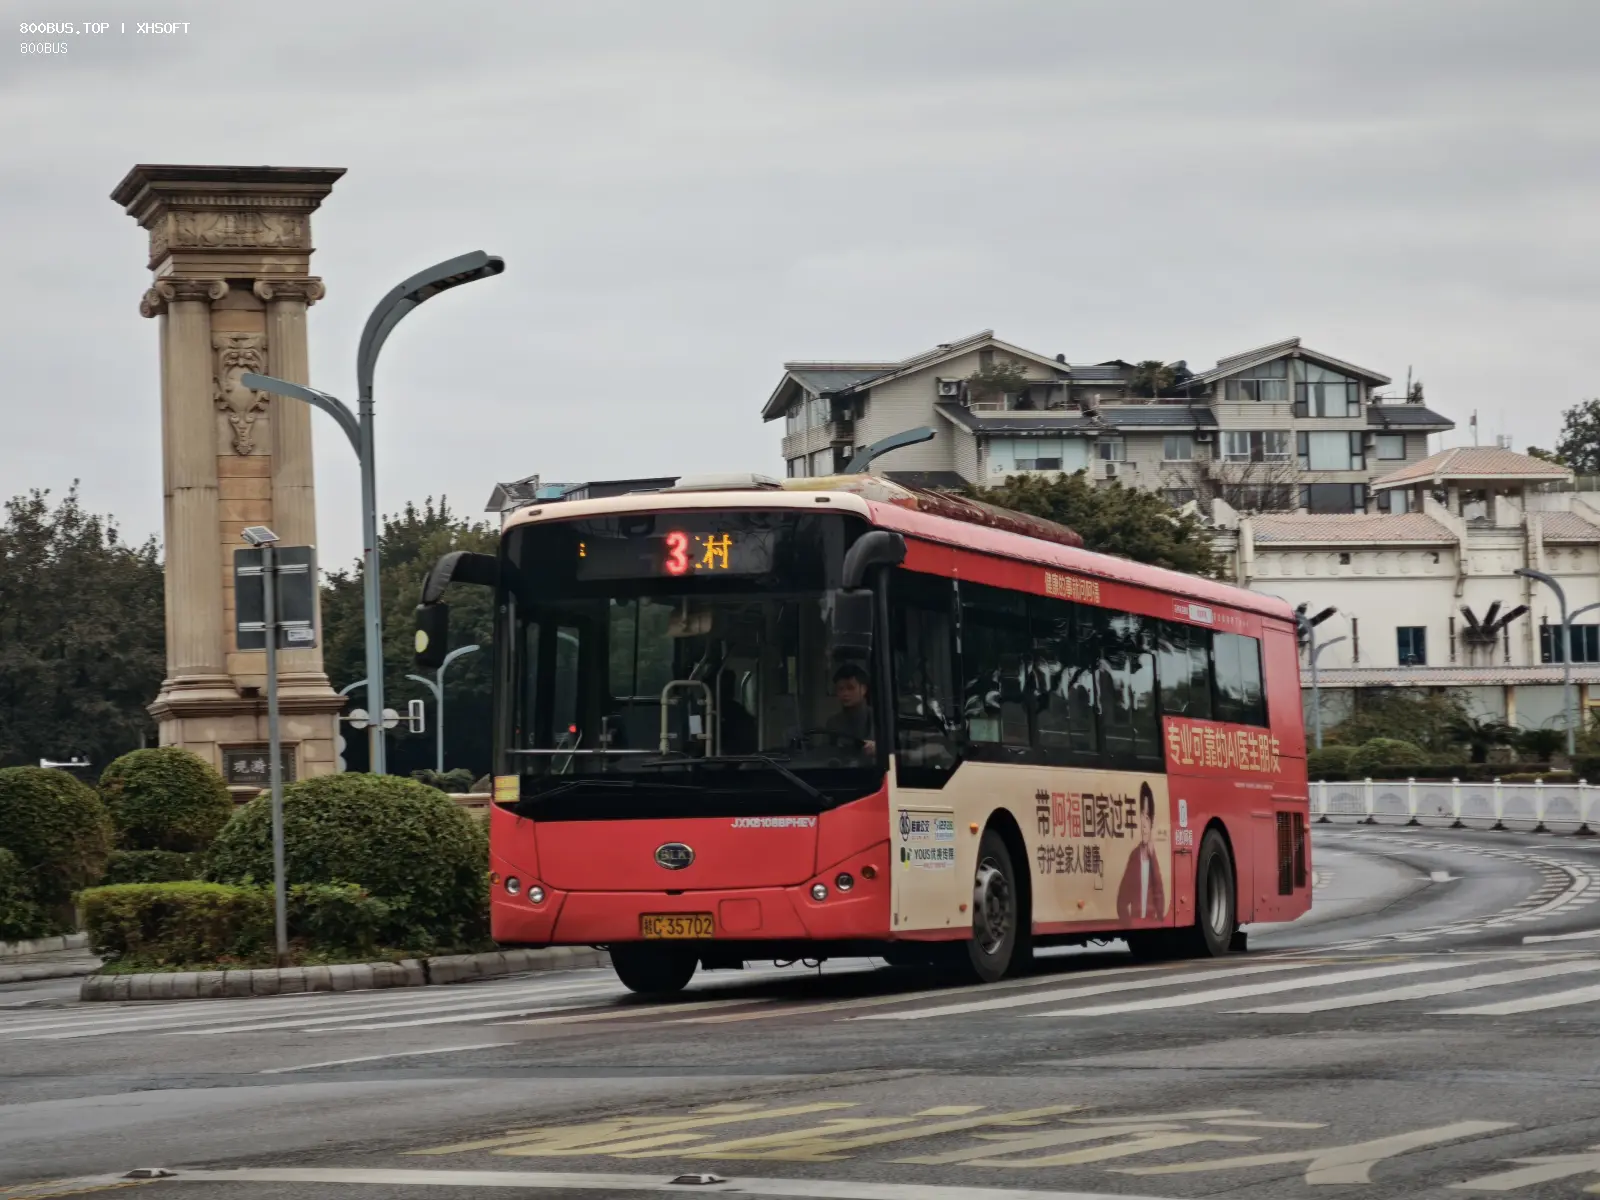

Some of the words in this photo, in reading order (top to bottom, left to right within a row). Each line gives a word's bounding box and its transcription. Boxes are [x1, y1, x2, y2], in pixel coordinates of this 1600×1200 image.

[665, 530, 690, 576] 3
[1167, 721, 1282, 774] 专业可靠的AI医生朋友
[1035, 788, 1138, 840] 带阿福回家过年
[1036, 844, 1102, 875] 守护全家人健康
